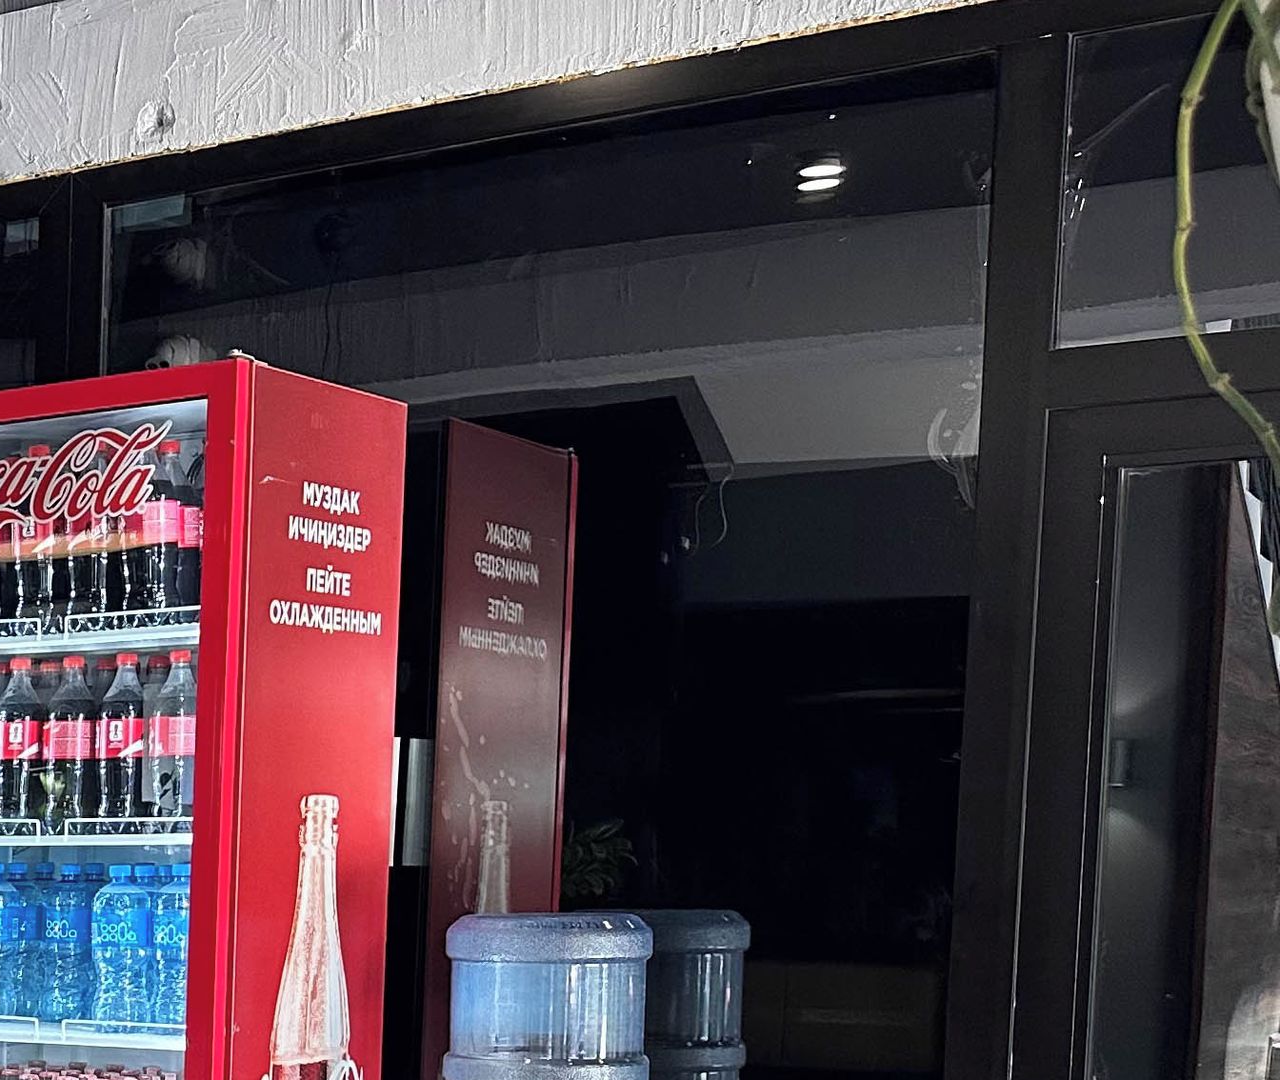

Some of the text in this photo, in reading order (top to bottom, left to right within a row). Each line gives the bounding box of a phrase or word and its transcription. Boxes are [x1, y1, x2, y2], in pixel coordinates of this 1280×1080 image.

[303, 481, 361, 516] МУЗДАК
[288, 515, 372, 554] ИЧИҢИЗДЕР
[306, 564, 352, 597] ПЕЙТЕ
[269, 599, 382, 636] ОХЛАЖДЕННЫМ
